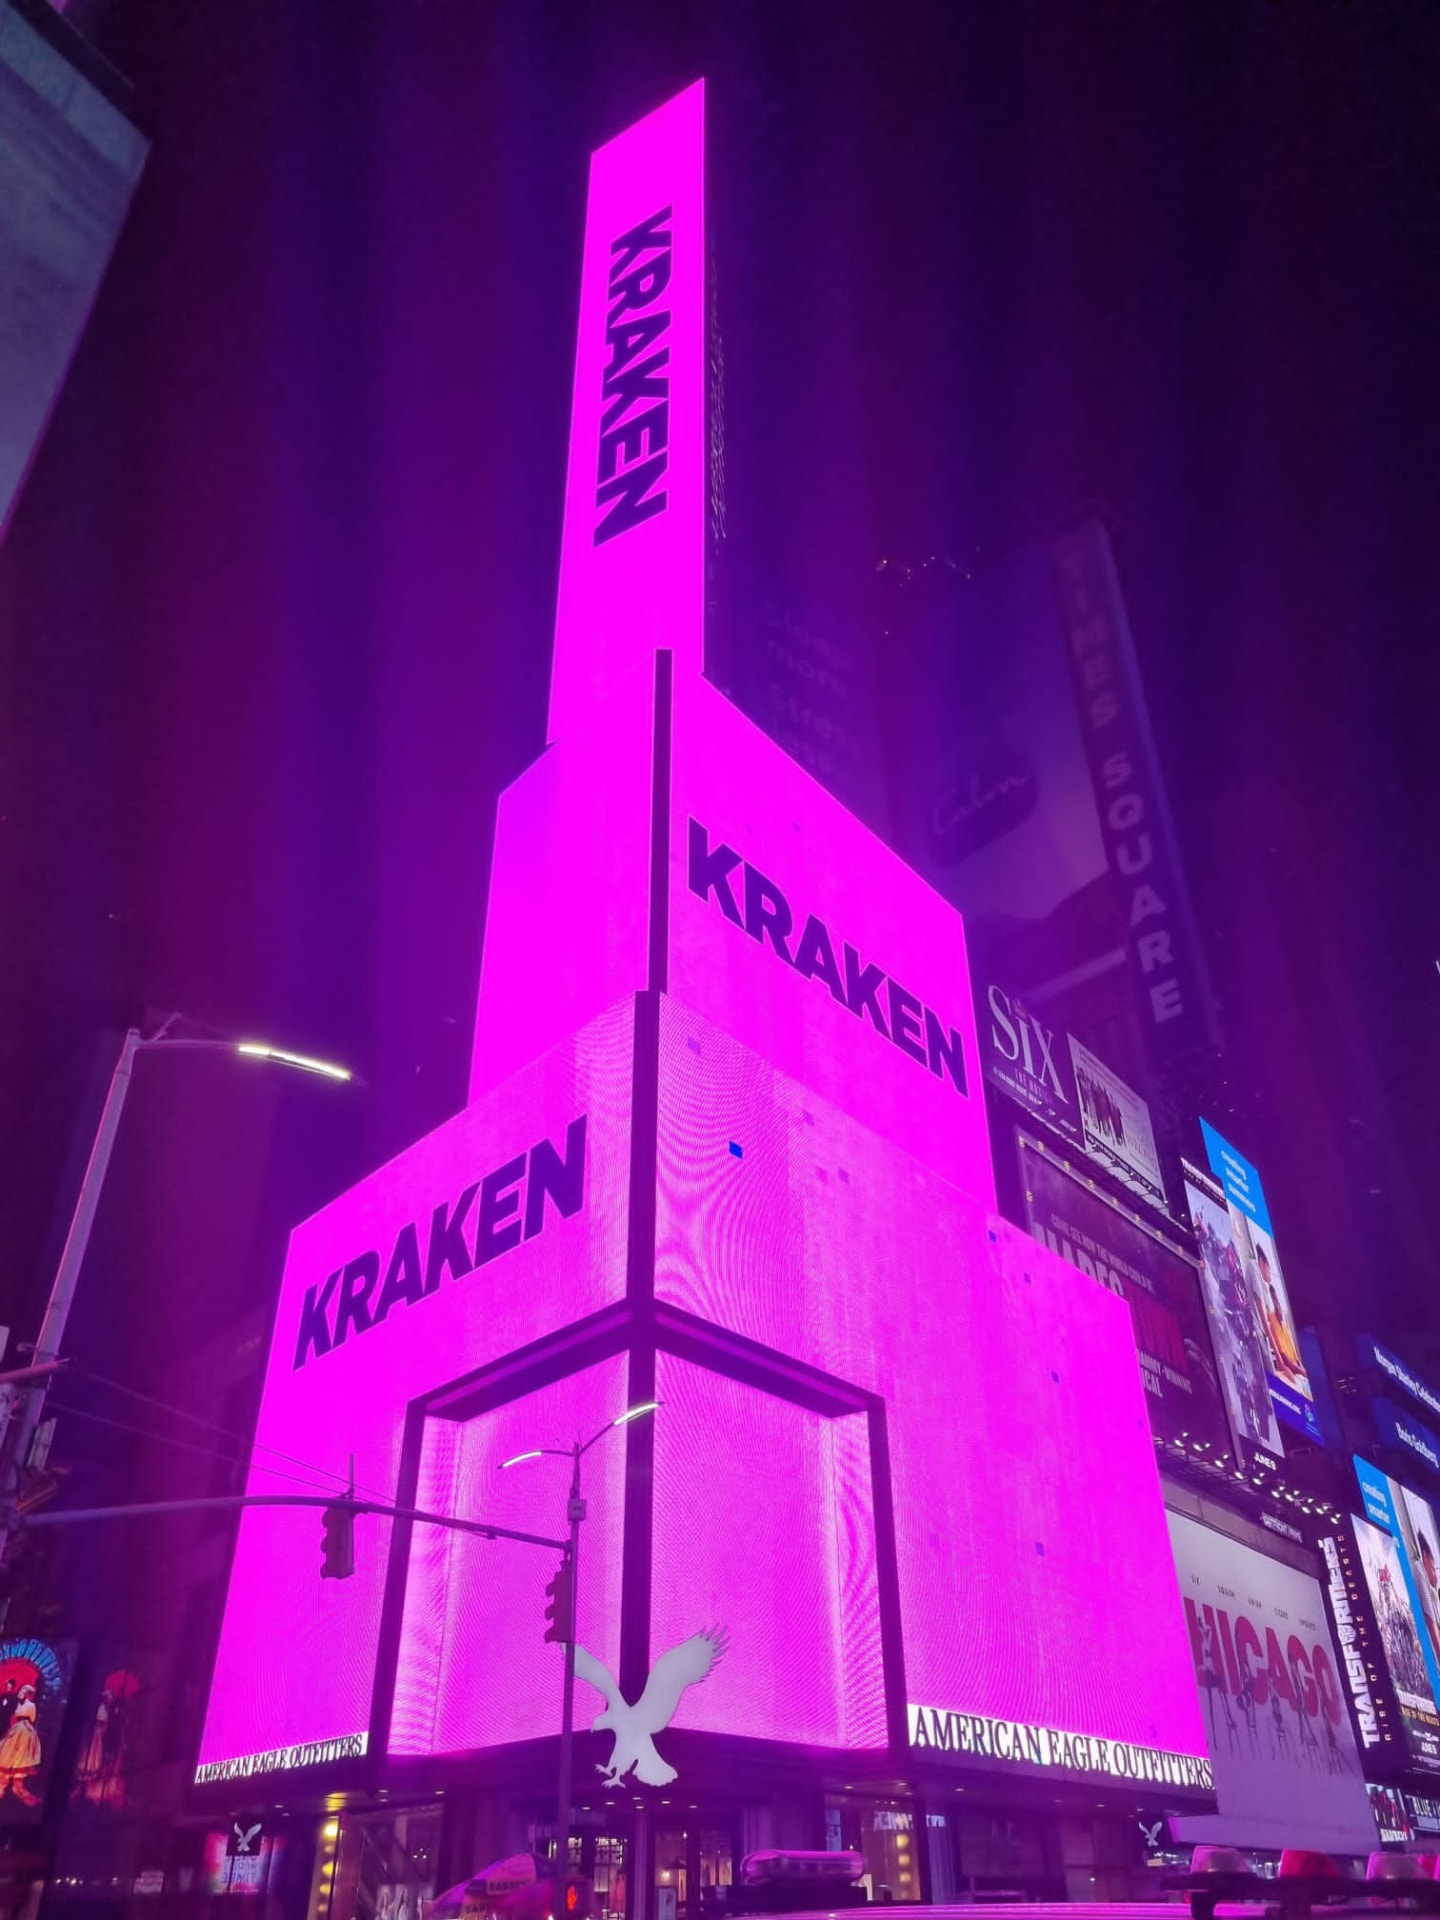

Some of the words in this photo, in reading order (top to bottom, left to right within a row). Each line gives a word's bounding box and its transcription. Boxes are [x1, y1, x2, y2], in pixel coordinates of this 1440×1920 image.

[593, 203, 672, 548] KRAKEN
[1103, 752, 1185, 1024] SQUARE
[688, 815, 968, 1098] KRAKEN
[988, 985, 1069, 1104] SIX
[293, 1114, 587, 1372] KRAKEN
[1183, 1597, 1342, 1726] HICAGO
[1356, 1615, 1370, 1648] THE
[196, 1757, 250, 1783] AMERICAN
[252, 1749, 288, 1773] EAGLE
[290, 1734, 362, 1768] OUTFITTERS
[915, 1706, 1043, 1764] AMERICAN
[1046, 1729, 1111, 1772] EAGLE
[1112, 1743, 1214, 1790] OUTFITTERS
[1412, 1796, 1433, 1817] BLUE
